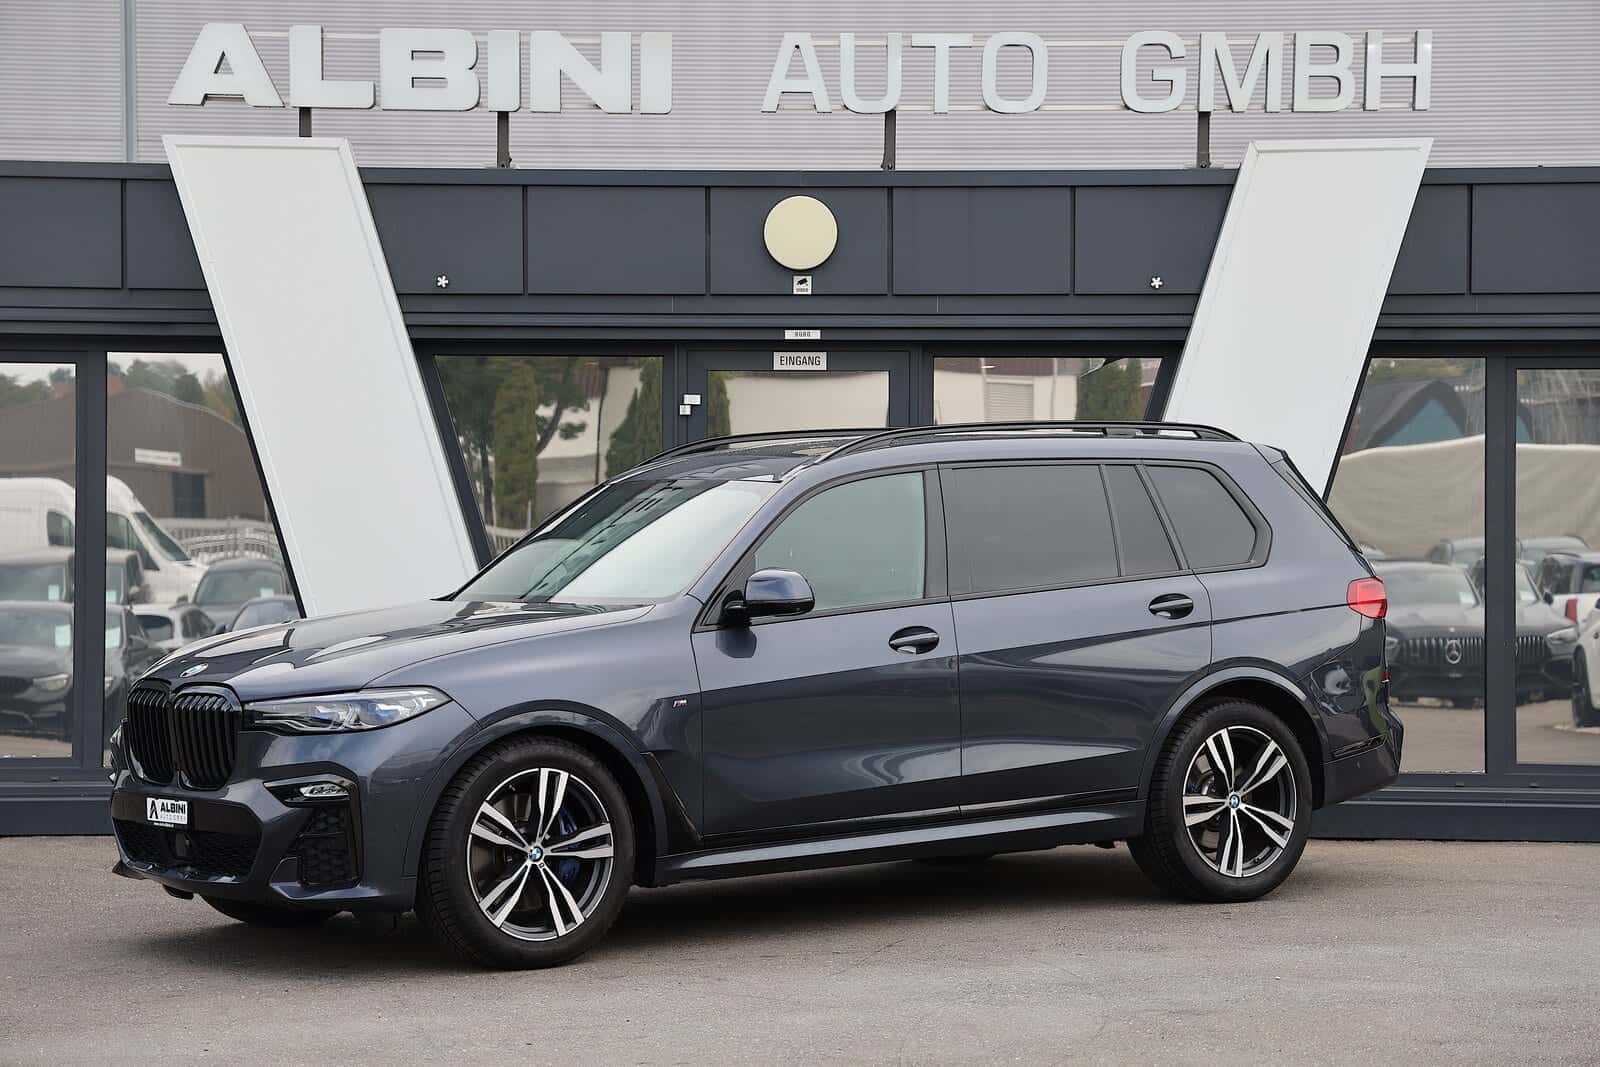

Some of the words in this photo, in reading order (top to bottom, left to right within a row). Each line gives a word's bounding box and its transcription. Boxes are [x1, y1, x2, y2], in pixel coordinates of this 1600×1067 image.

[168, 23, 673, 114] ALBINI
[762, 31, 1049, 114] AUTO
[1119, 29, 1434, 113] GMBH
[779, 355, 821, 366] EINGANG
[160, 801, 186, 814] ALBINI
